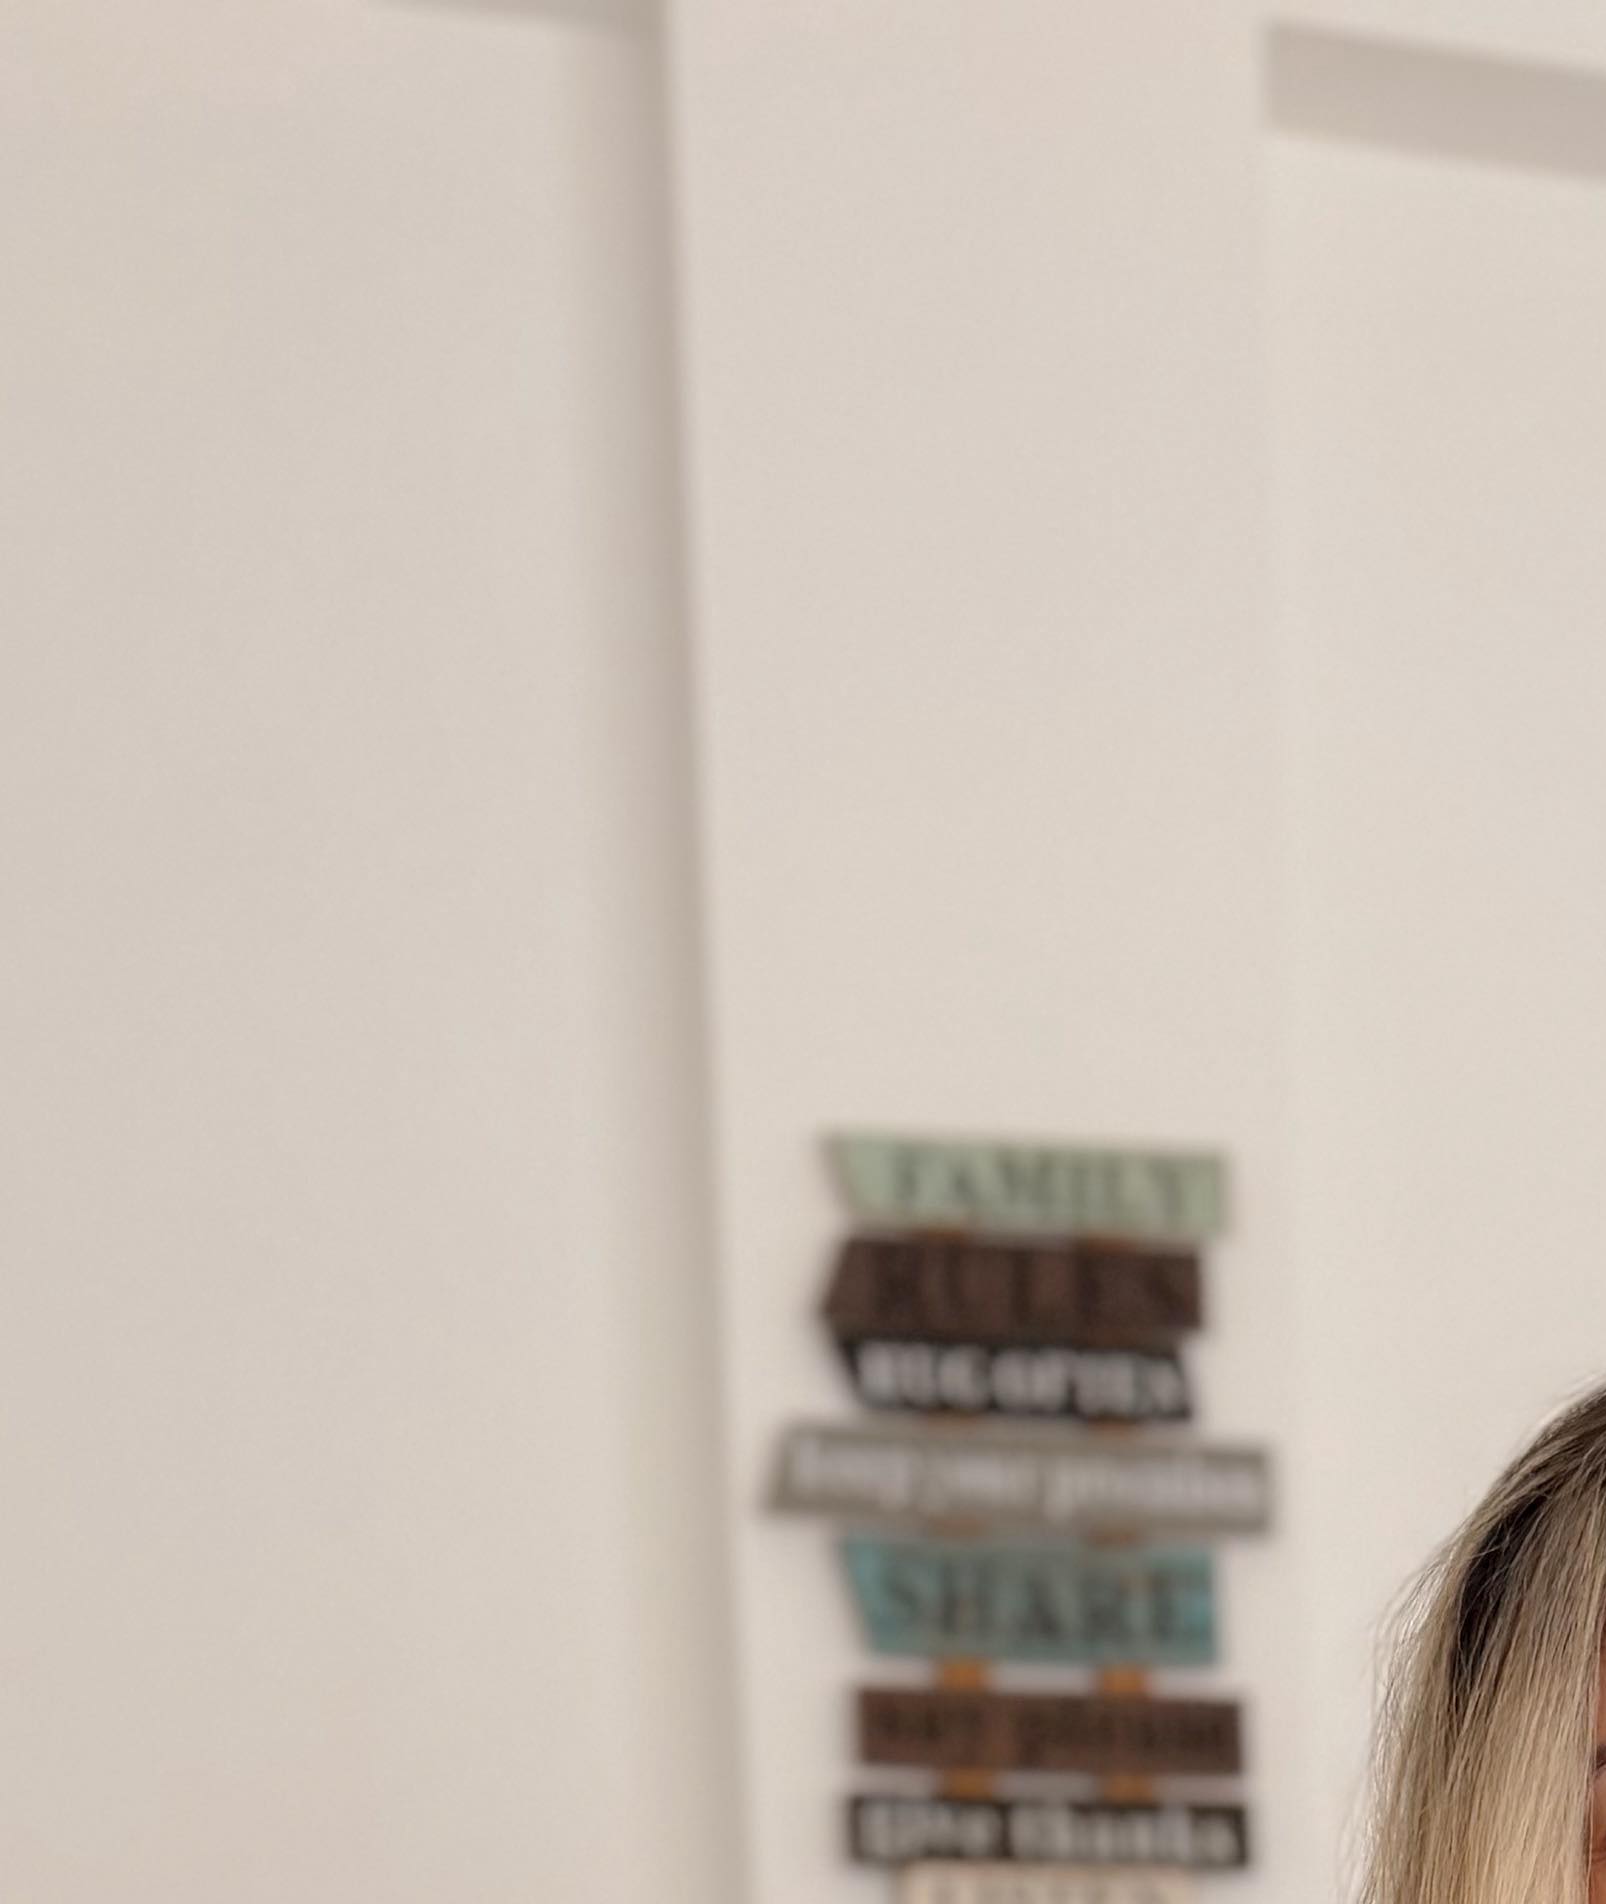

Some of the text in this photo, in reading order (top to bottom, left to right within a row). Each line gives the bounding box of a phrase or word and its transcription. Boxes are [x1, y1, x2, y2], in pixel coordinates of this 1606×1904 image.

[886, 1145, 1198, 1226] FAMILY
[868, 1243, 1192, 1332] RULES
[884, 1556, 1200, 1648] SHARE
